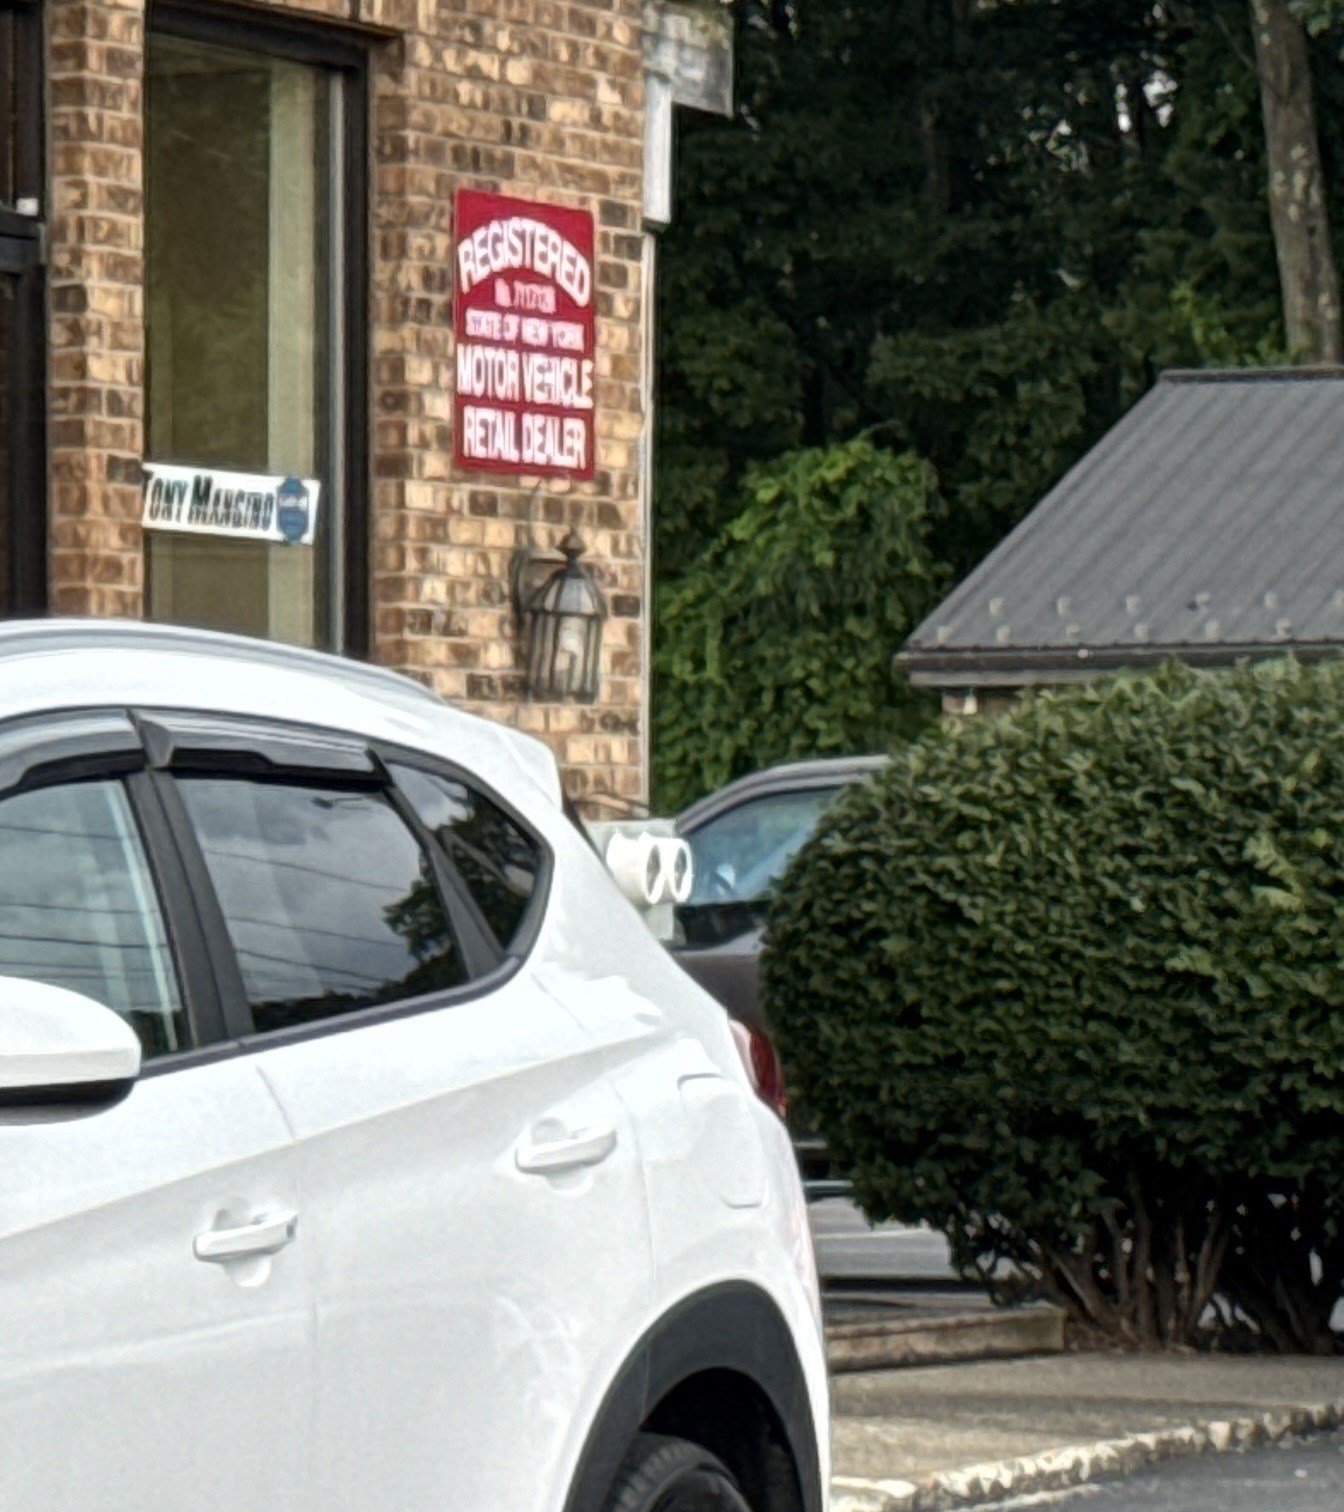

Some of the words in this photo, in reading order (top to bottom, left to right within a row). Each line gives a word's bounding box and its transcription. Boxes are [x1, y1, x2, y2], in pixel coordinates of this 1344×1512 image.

[456, 216, 591, 308] REGISTERED
[456, 342, 520, 402] MOTOR
[522, 351, 593, 409] VEHICLE
[463, 404, 520, 463] RETAIL
[521, 412, 587, 470] DEALER
[146, 472, 190, 523] ONY
